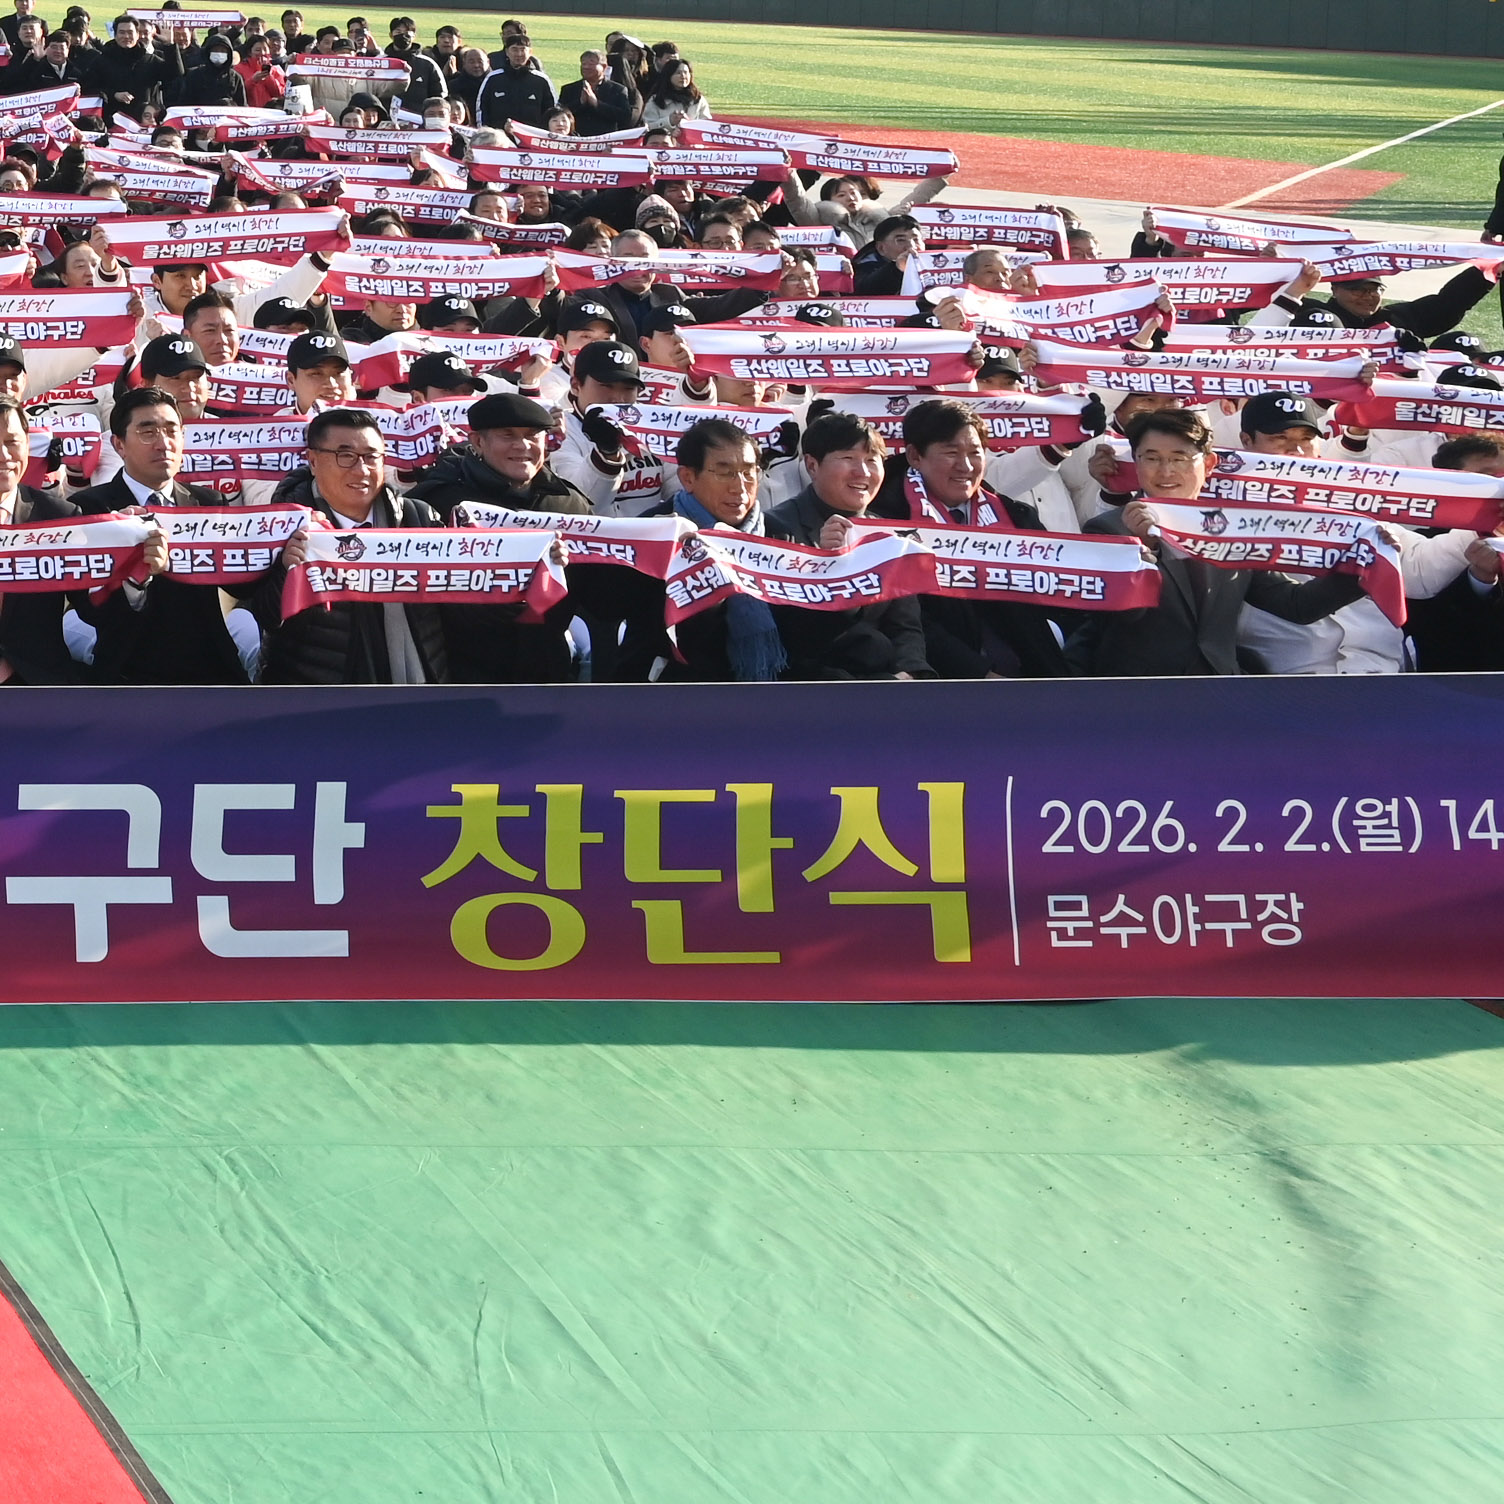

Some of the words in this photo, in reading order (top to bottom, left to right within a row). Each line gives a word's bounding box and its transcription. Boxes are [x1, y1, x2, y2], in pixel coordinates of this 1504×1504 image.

[806, 153, 864, 172] 울산웨일즈
[867, 159, 929, 176] 프로야구단
[498, 168, 556, 182] 울산웨일즈
[558, 171, 619, 187] 프로야구단
[142, 238, 226, 260] 울산웨일즈
[229, 231, 305, 254] 프로야구단
[992, 227, 1055, 248] 프로야구단
[1185, 231, 1252, 252] 울산웨일즈
[344, 275, 426, 297] 울산웨일즈
[430, 279, 510, 298] 프로야구단
[729, 358, 825, 379] 울산웨일즈
[829, 357, 930, 378] 프로야구단
[1087, 370, 1196, 396] 울산웨일즈
[1257, 459, 1293, 478] 그래!
[1300, 462, 1339, 482] 역시!
[1348, 466, 1399, 487] 최강!
[1304, 490, 1437, 519] 프로야구단
[25, 529, 73, 546] 최강!
[172, 520, 207, 539] 그래!
[212, 518, 252, 538] 역시!
[257, 514, 305, 537] 최강!
[1237, 514, 1271, 533] 그래!
[1273, 518, 1312, 536] 역시!
[1314, 518, 1362, 538] 최강!
[931, 537, 970, 556] 그래!
[973, 538, 1009, 557] 역시!
[1017, 539, 1063, 562] 최강!
[306, 567, 418, 594] 울산웨일즈
[766, 572, 882, 605] 프로야구단
[985, 567, 1106, 600] 프로야구단
[1040, 799, 1198, 854] 2026.
[1216, 799, 1264, 853] 2.
[1281, 797, 1424, 853] 2.(월)
[420, 781, 972, 971] 창단식
[1046, 892, 1305, 948] 문수야구장
